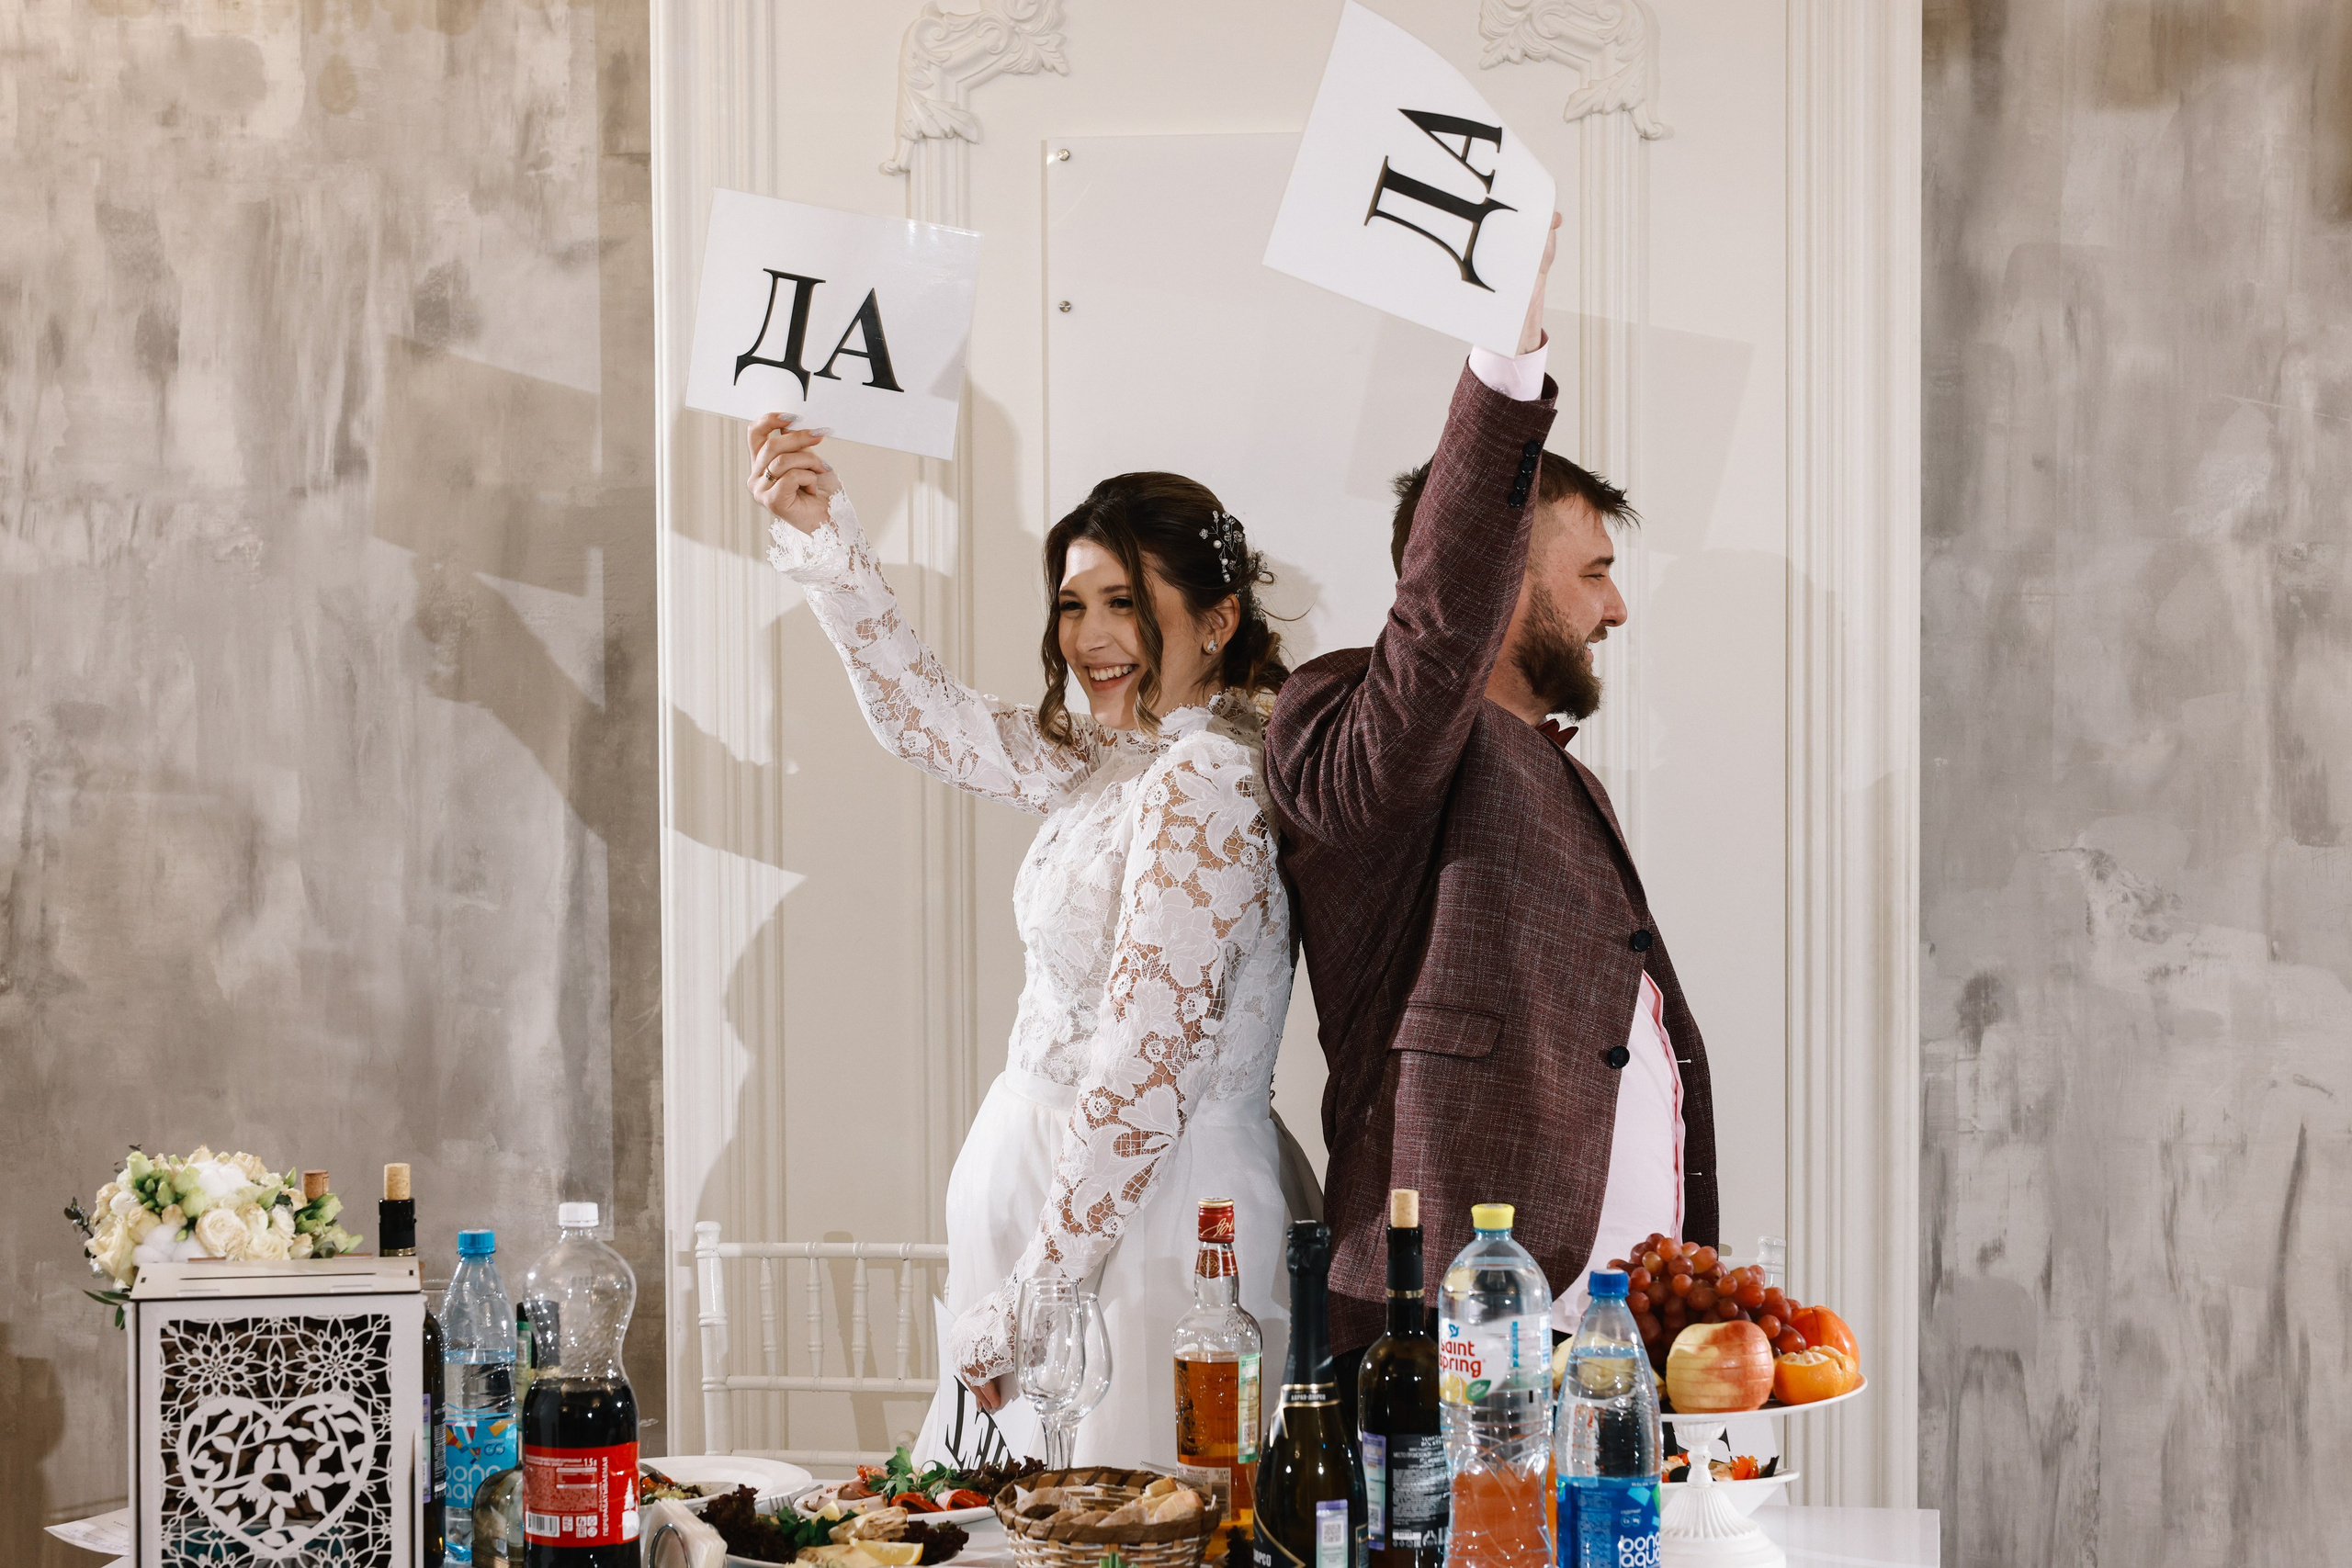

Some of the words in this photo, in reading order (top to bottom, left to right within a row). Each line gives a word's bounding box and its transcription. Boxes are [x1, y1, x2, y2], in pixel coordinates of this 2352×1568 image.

[1366, 108, 1518, 292] ДА
[733, 268, 905, 401] ДА
[1441, 1338, 1475, 1357] saint
[1440, 1354, 1482, 1378] spring
[1618, 1531, 1660, 1553] bona
